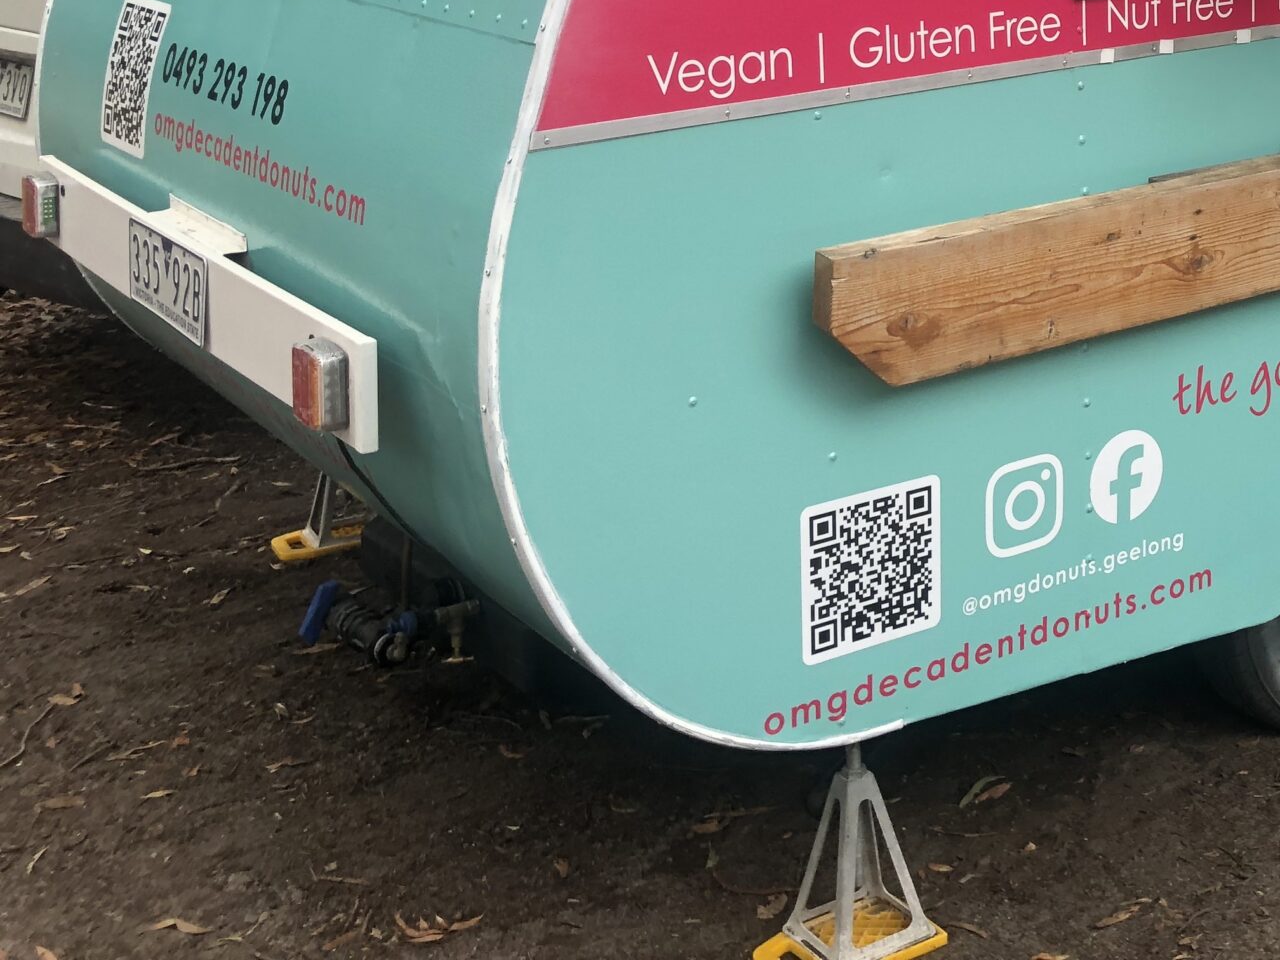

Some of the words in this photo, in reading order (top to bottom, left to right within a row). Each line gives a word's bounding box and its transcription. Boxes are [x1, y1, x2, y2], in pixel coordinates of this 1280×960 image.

[162, 42, 208, 94] 0493
[207, 58, 248, 110] 293
[251, 72, 289, 125] 198
[647, 47, 793, 99] Vegan
[849, 20, 976, 68] Gluten
[989, 10, 1061, 50] Free
[154, 112, 366, 226] omgdecadentdonuts.com
[132, 233, 160, 295] 335
[172, 256, 201, 322] 92B
[1172, 364, 1238, 416] the
[961, 530, 1186, 617] @omgdonuts.geelong
[763, 566, 1213, 737] omgdecadentdonuts.com
